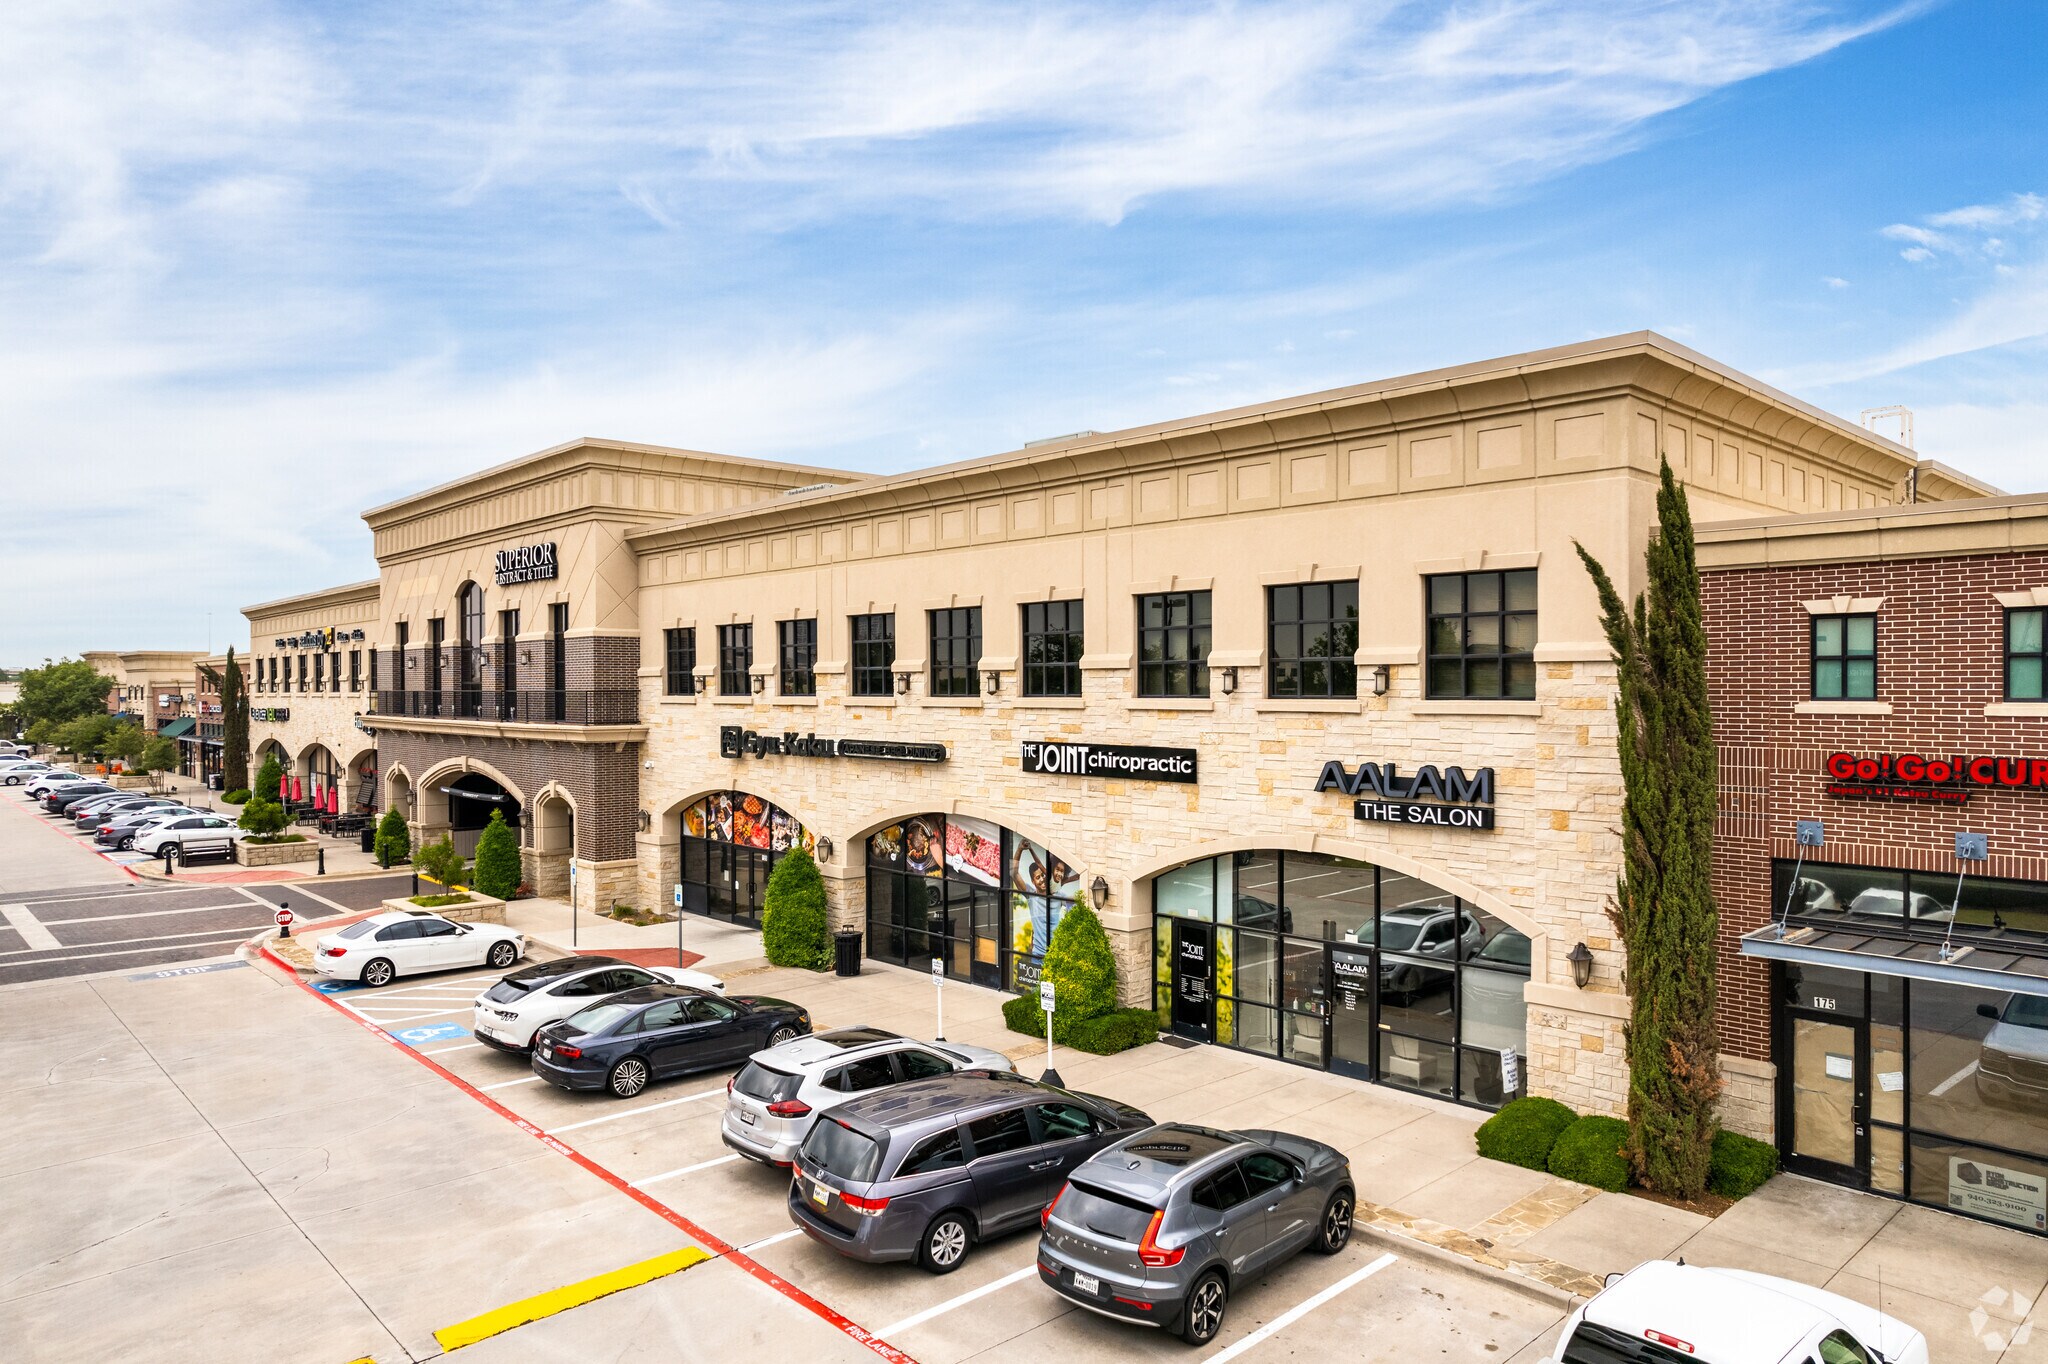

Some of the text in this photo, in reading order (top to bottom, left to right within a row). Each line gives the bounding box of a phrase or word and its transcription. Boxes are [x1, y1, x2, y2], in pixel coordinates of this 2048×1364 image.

[495, 542, 553, 572] SUPERIOR
[533, 564, 553, 579] TITLE
[1021, 743, 1037, 758] THE
[1088, 752, 1192, 773] chiropractic
[1314, 761, 1495, 803] AALAM
[1932, 789, 1968, 803] Curry
[1360, 803, 1483, 827] THE SALON
[277, 913, 292, 922] STOP
[155, 966, 212, 978] STOP
[1335, 963, 1367, 974] AALAM
[1815, 997, 1834, 1009] 175
[1967, 1193, 2027, 1212] 940.323.9100
[845, 1325, 871, 1342] FIRE
